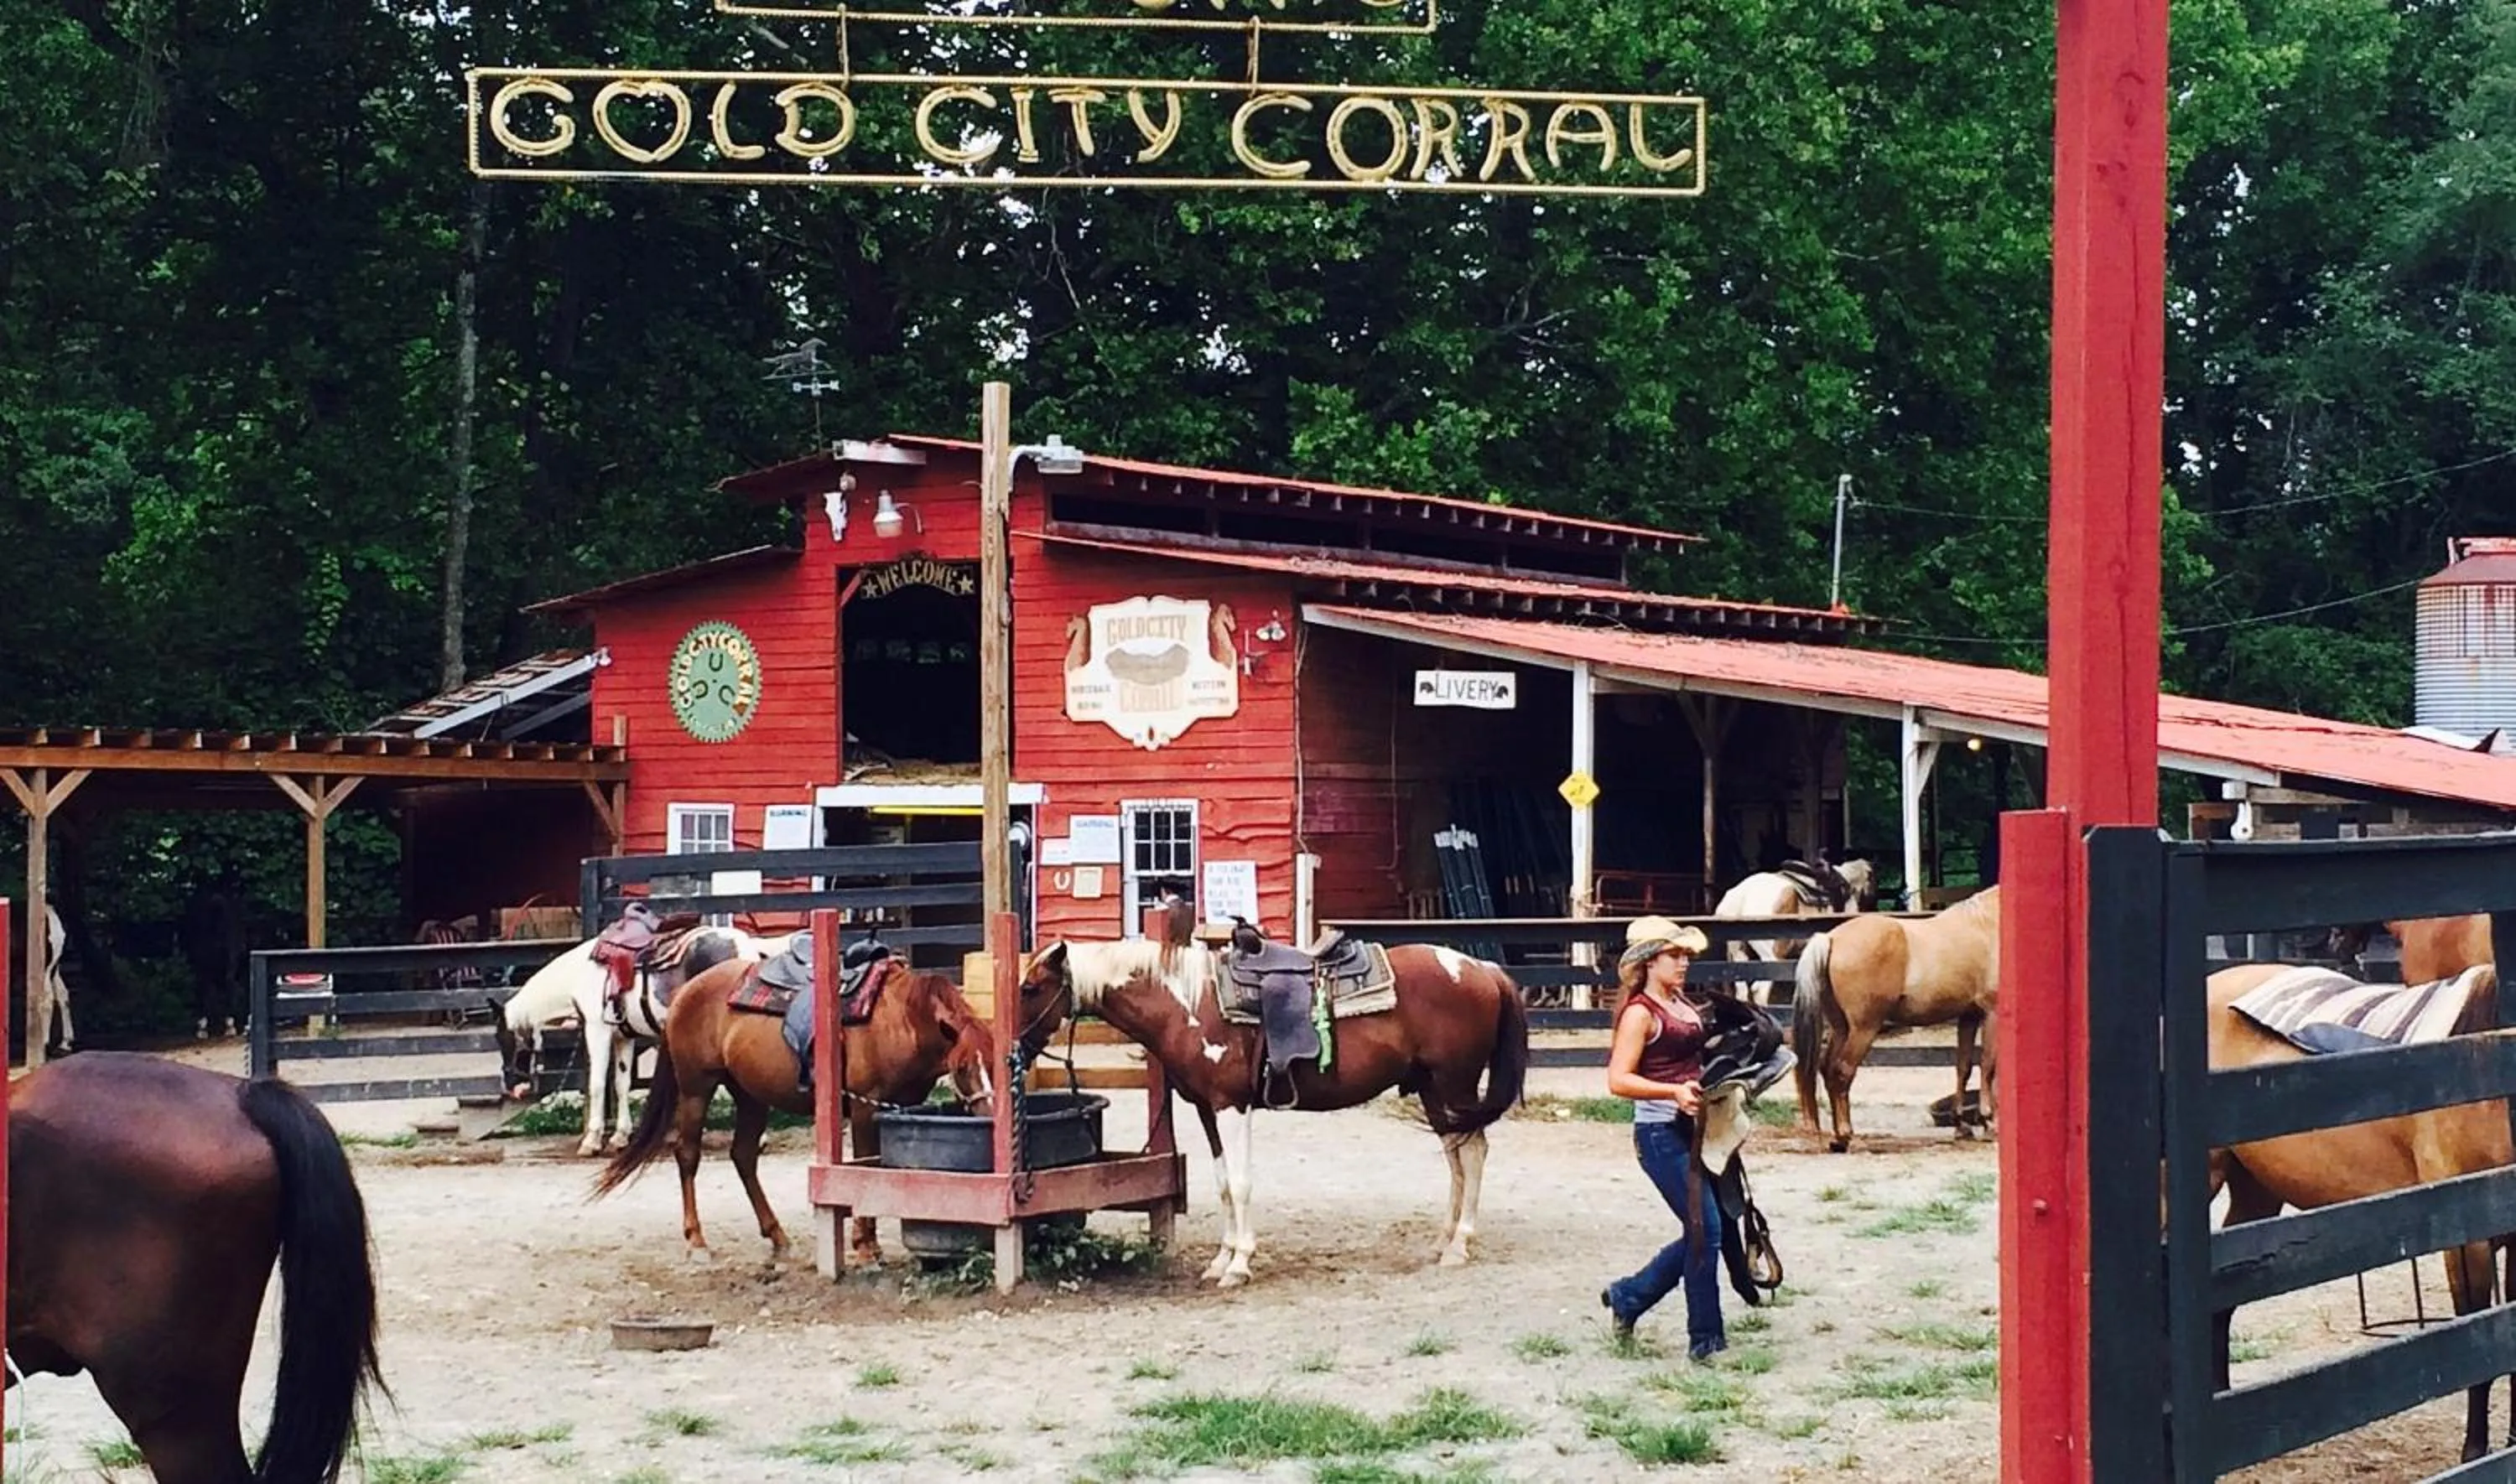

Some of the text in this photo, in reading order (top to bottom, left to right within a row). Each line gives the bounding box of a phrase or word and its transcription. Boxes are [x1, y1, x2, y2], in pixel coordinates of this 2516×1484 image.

[489, 78, 1692, 183] GOLD CITY CORRAL
[876, 560, 956, 595] WELCOME
[1435, 672, 1499, 702] LIVERY
